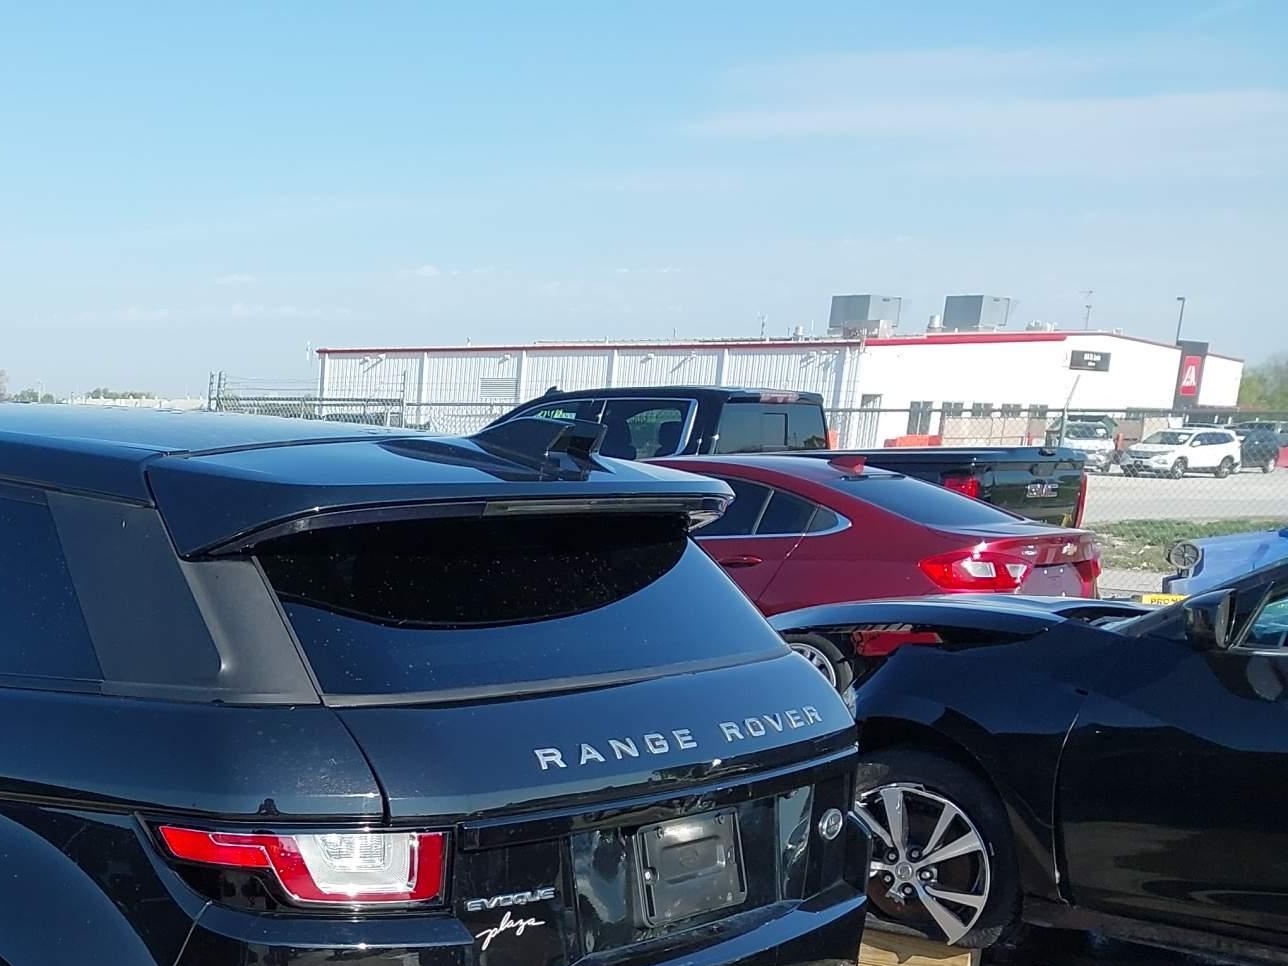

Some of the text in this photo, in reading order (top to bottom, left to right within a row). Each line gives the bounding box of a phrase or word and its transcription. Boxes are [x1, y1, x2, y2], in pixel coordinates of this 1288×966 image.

[533, 704, 823, 770] RANGE ROVER
[465, 887, 555, 911] EVOQUE
